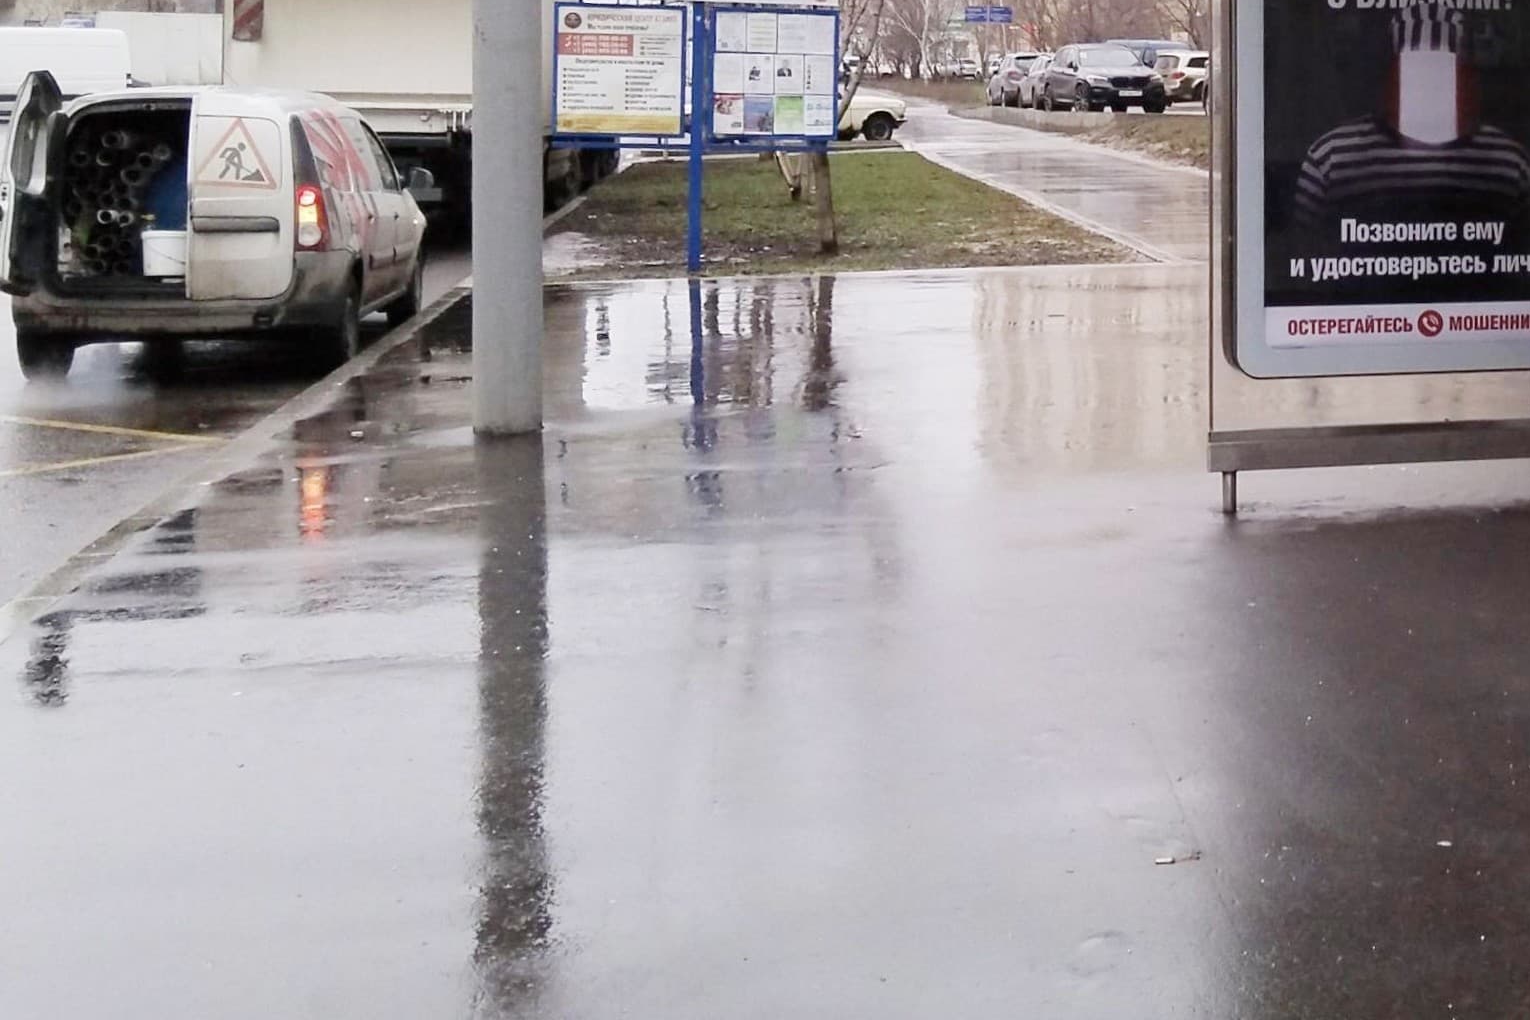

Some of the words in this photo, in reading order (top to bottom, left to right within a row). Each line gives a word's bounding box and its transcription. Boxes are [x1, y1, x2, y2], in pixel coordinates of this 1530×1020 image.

[1340, 218, 1457, 244] Позвоните
[1463, 221, 1505, 245] ему
[1290, 258, 1305, 278] и
[1310, 255, 1487, 282] удостоверьтесь
[1287, 315, 1414, 336] ОСТЕРЕГАЙТЕСЬ
